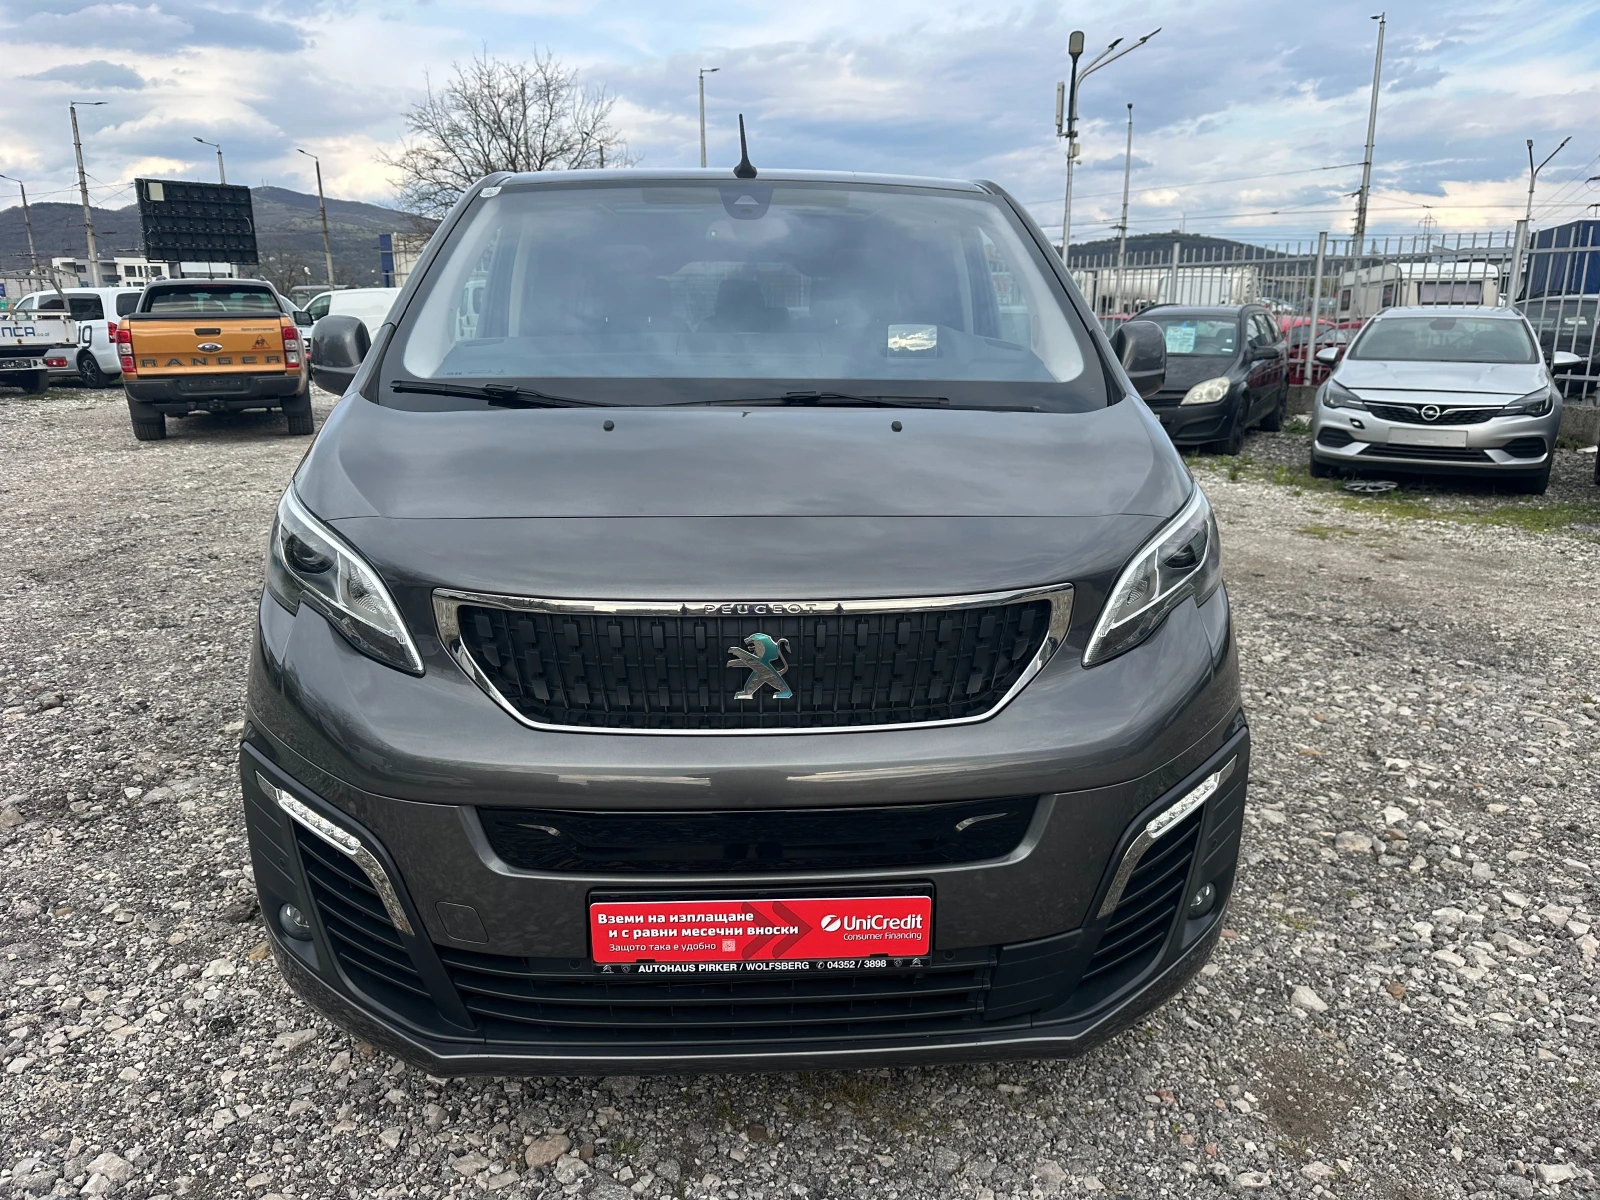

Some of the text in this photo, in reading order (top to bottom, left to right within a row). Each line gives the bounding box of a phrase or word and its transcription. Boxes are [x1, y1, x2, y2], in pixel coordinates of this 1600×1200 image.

[140, 355, 282, 367] RANGER
[704, 603, 817, 615] PEUGEOT
[597, 913, 644, 924] Вземи
[669, 913, 754, 924] изплащане
[843, 914, 923, 930] UniCredit
[608, 926, 799, 940] и с равни месечни вноски
[843, 932, 922, 941] Consumer Financing
[609, 942, 716, 952] Защото така е удобно
[638, 963, 696, 973] AUTOHAUS
[698, 962, 737, 972] PIRKER
[745, 961, 810, 971] WOLFSBERG
[827, 960, 856, 969] 04352
[863, 959, 887, 968] 3898
